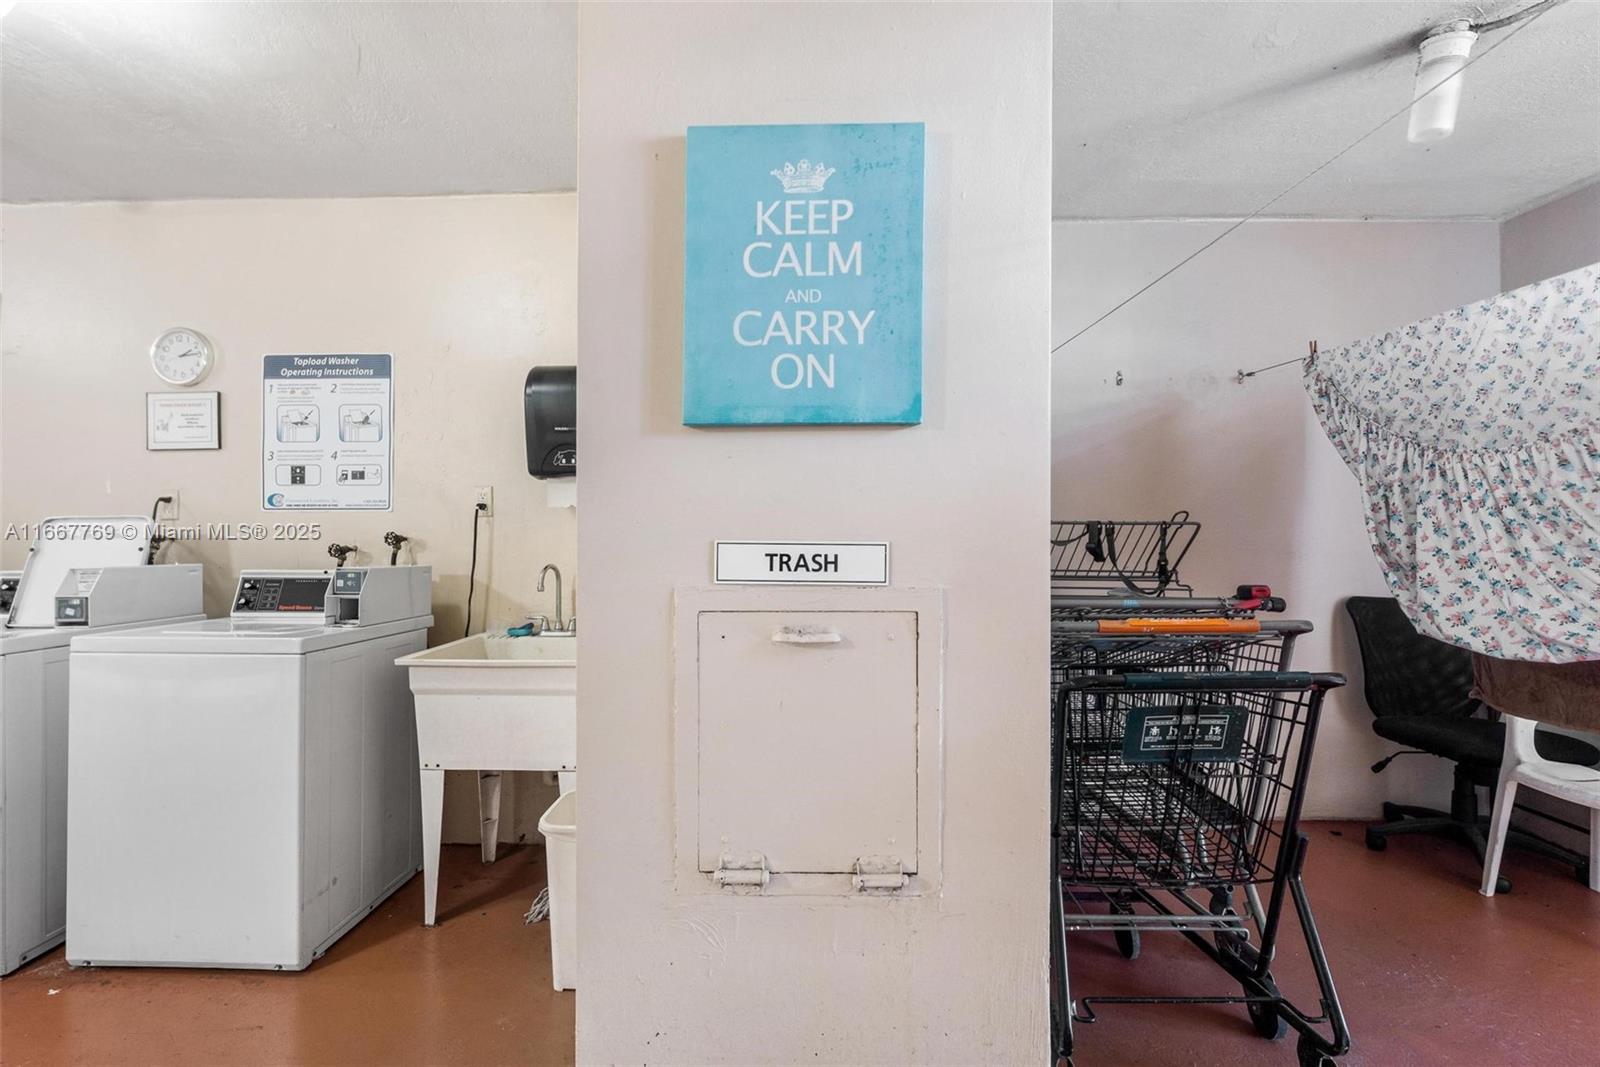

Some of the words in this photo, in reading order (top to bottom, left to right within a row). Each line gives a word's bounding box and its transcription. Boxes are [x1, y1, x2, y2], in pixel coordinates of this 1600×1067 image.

[755, 199, 854, 236] KEEP
[742, 241, 862, 278] CALM
[785, 288, 822, 304] AND
[732, 310, 876, 346] CARRY
[293, 357, 326, 367] Topload
[328, 356, 360, 365] Washer
[280, 368, 323, 378] Operating
[323, 367, 374, 376] Instructions
[770, 353, 835, 389] ON
[268, 384, 274, 394] 1
[330, 383, 337, 393] 2
[267, 451, 274, 461] 3
[330, 451, 338, 460] 4
[765, 553, 839, 573] TRASH
